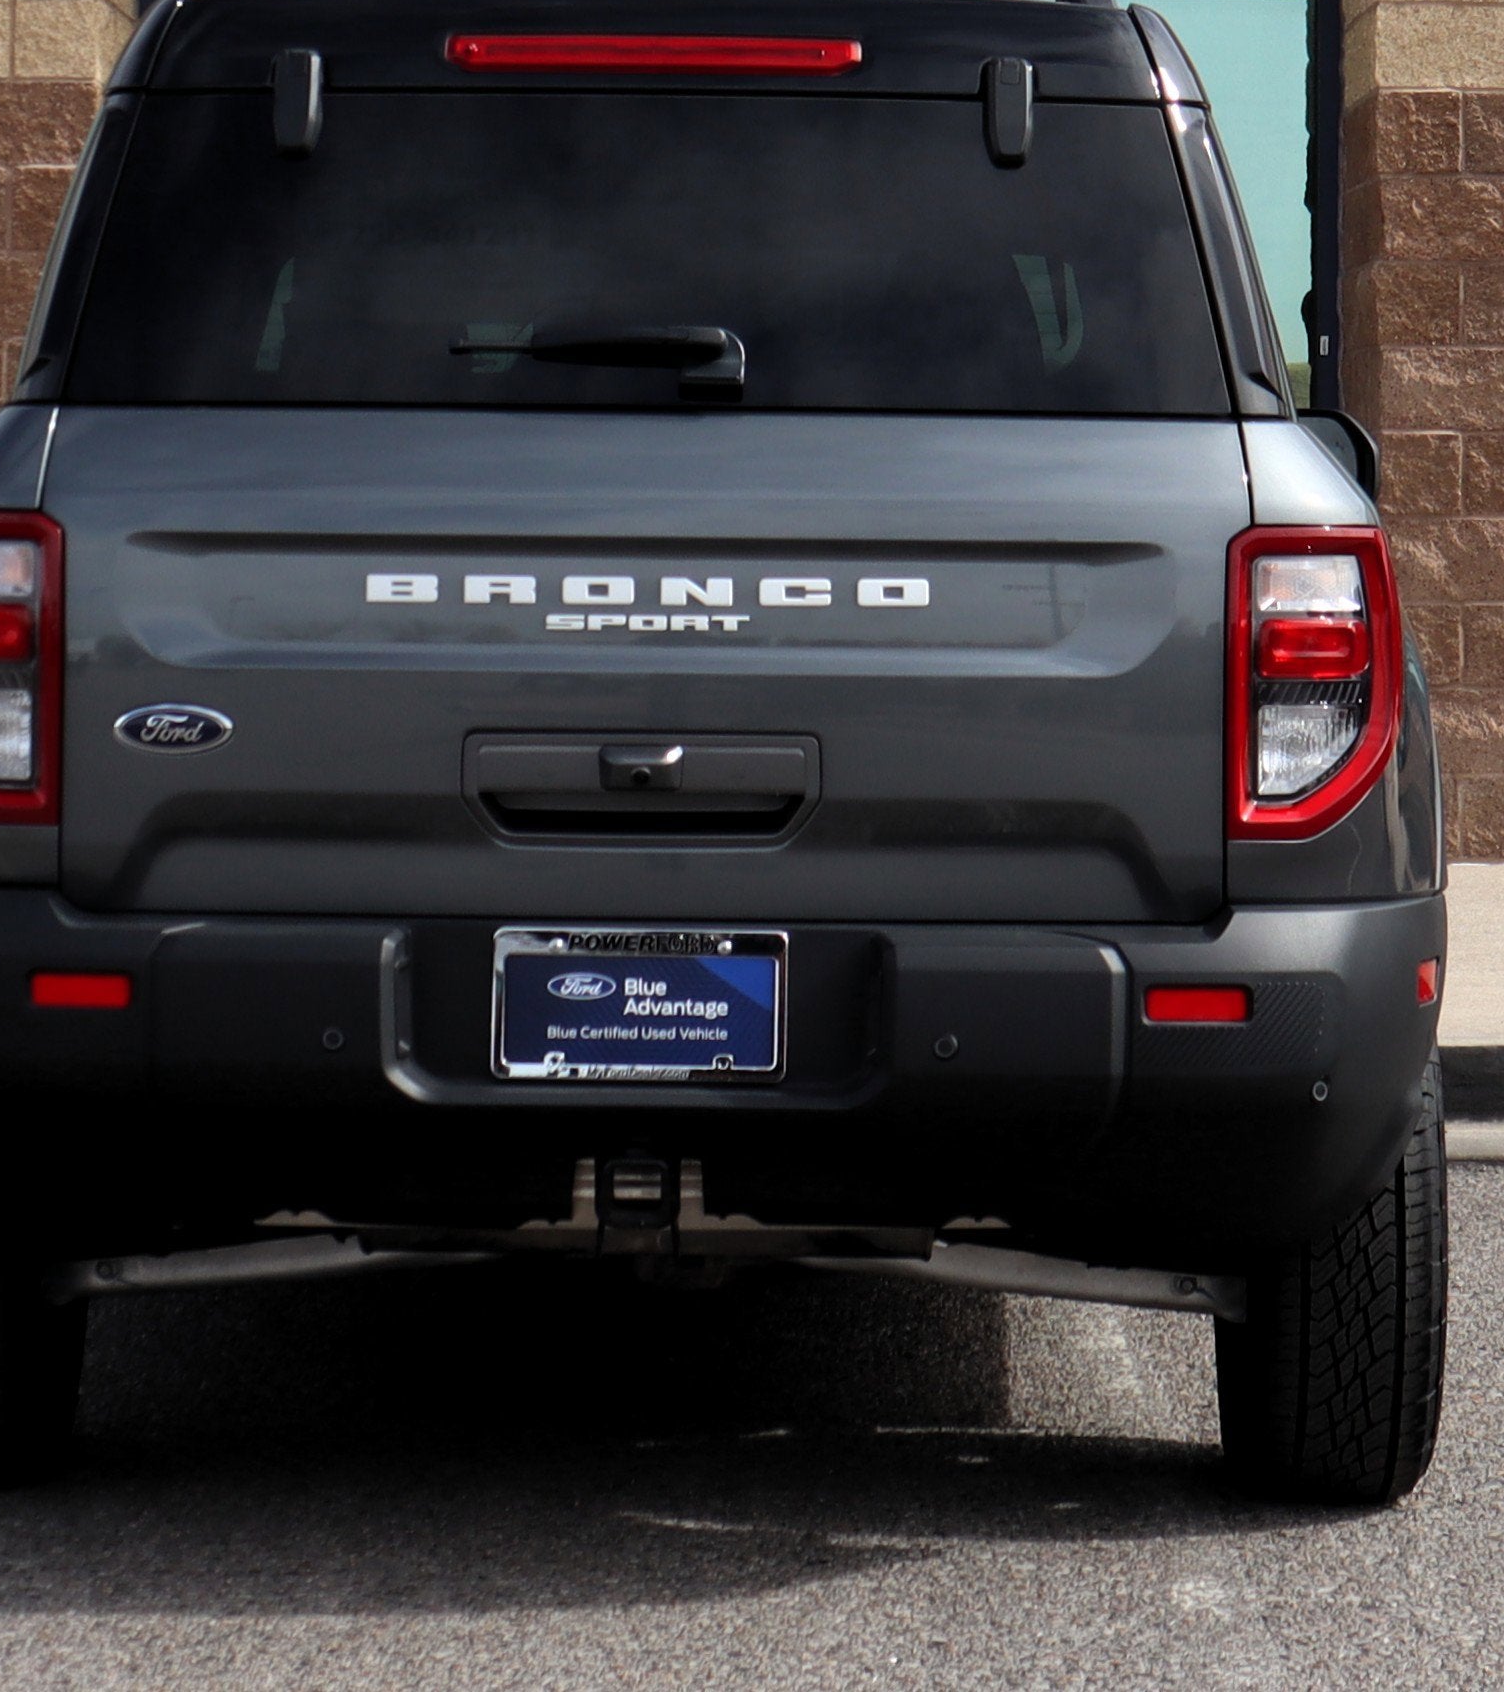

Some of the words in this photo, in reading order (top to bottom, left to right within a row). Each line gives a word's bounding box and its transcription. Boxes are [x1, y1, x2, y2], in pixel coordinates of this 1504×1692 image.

[365, 573, 930, 607] BRONCO
[545, 614, 751, 632] SPORT
[139, 713, 205, 743] Ford
[560, 977, 603, 997] Ford
[624, 977, 667, 996] Blue
[623, 998, 729, 1019] Advantage
[547, 1025, 577, 1040] Blue
[580, 1025, 638, 1041] Certified
[641, 1026, 676, 1041] Used
[679, 1027, 728, 1041] Vehicle
